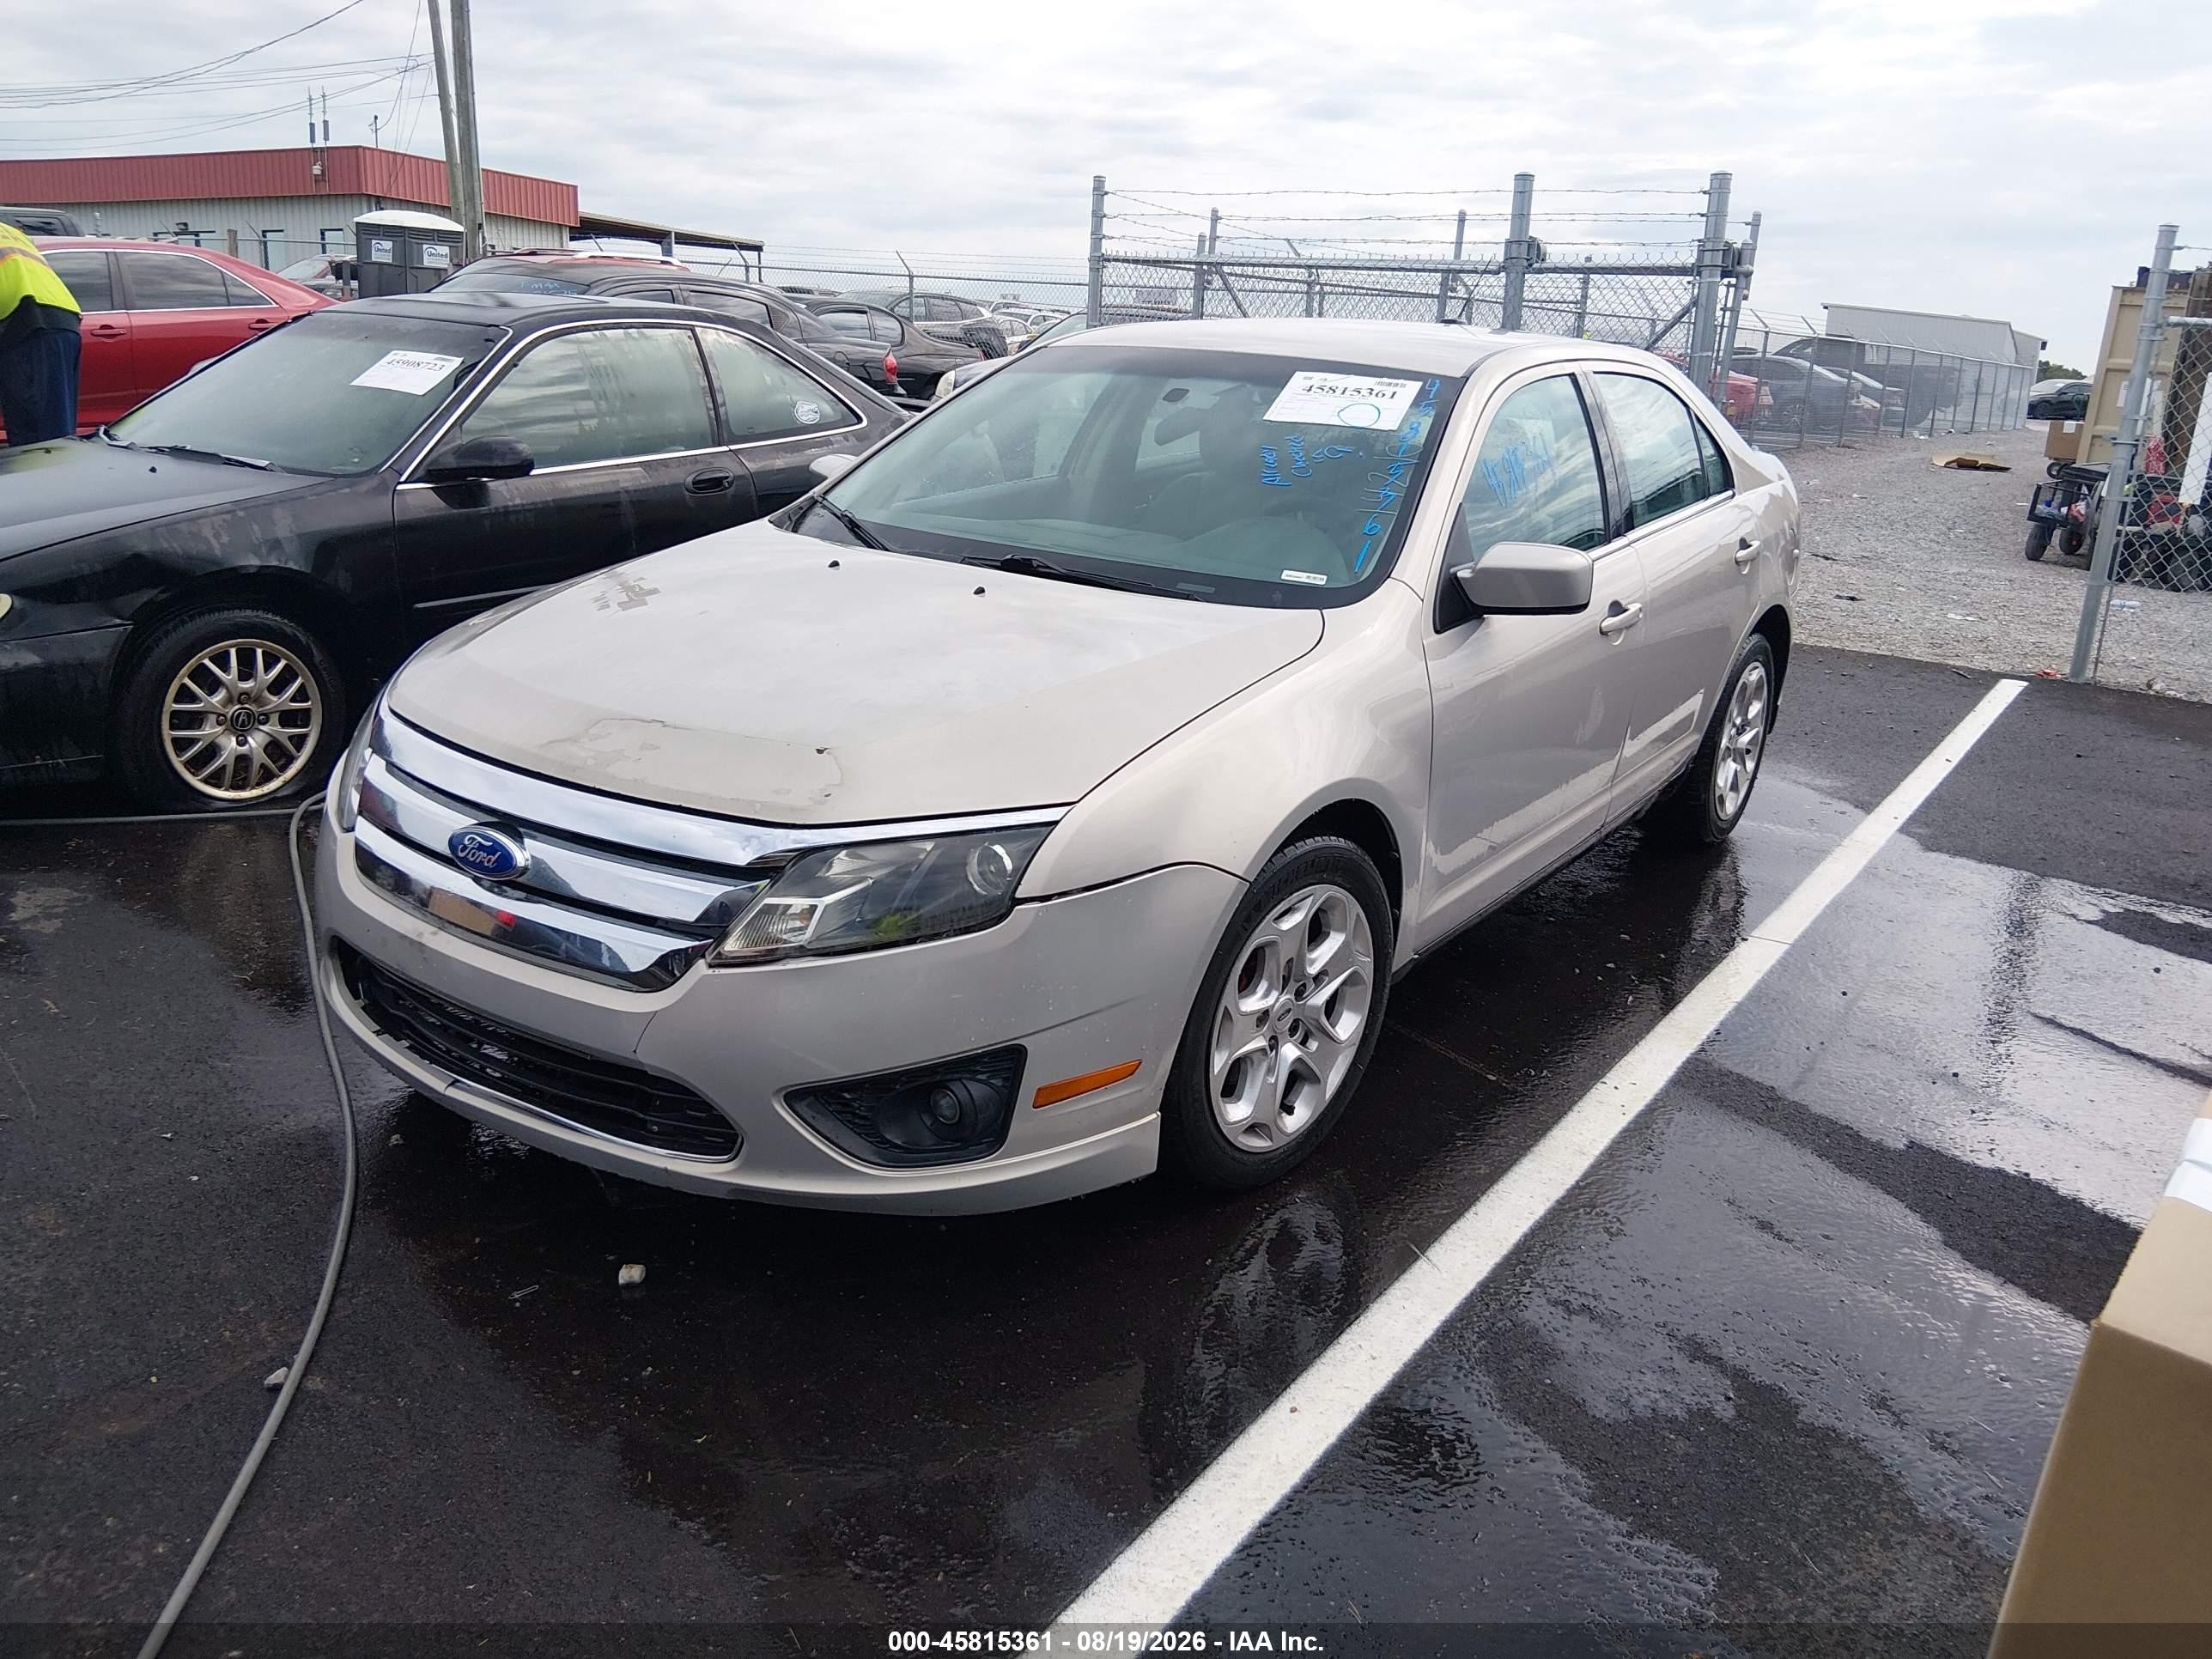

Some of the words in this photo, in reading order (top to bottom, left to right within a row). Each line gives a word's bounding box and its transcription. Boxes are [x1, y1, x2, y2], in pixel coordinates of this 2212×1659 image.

[427, 250, 448, 258] United
[1302, 384, 1398, 400] 45815361
[458, 834, 502, 867] Ford
